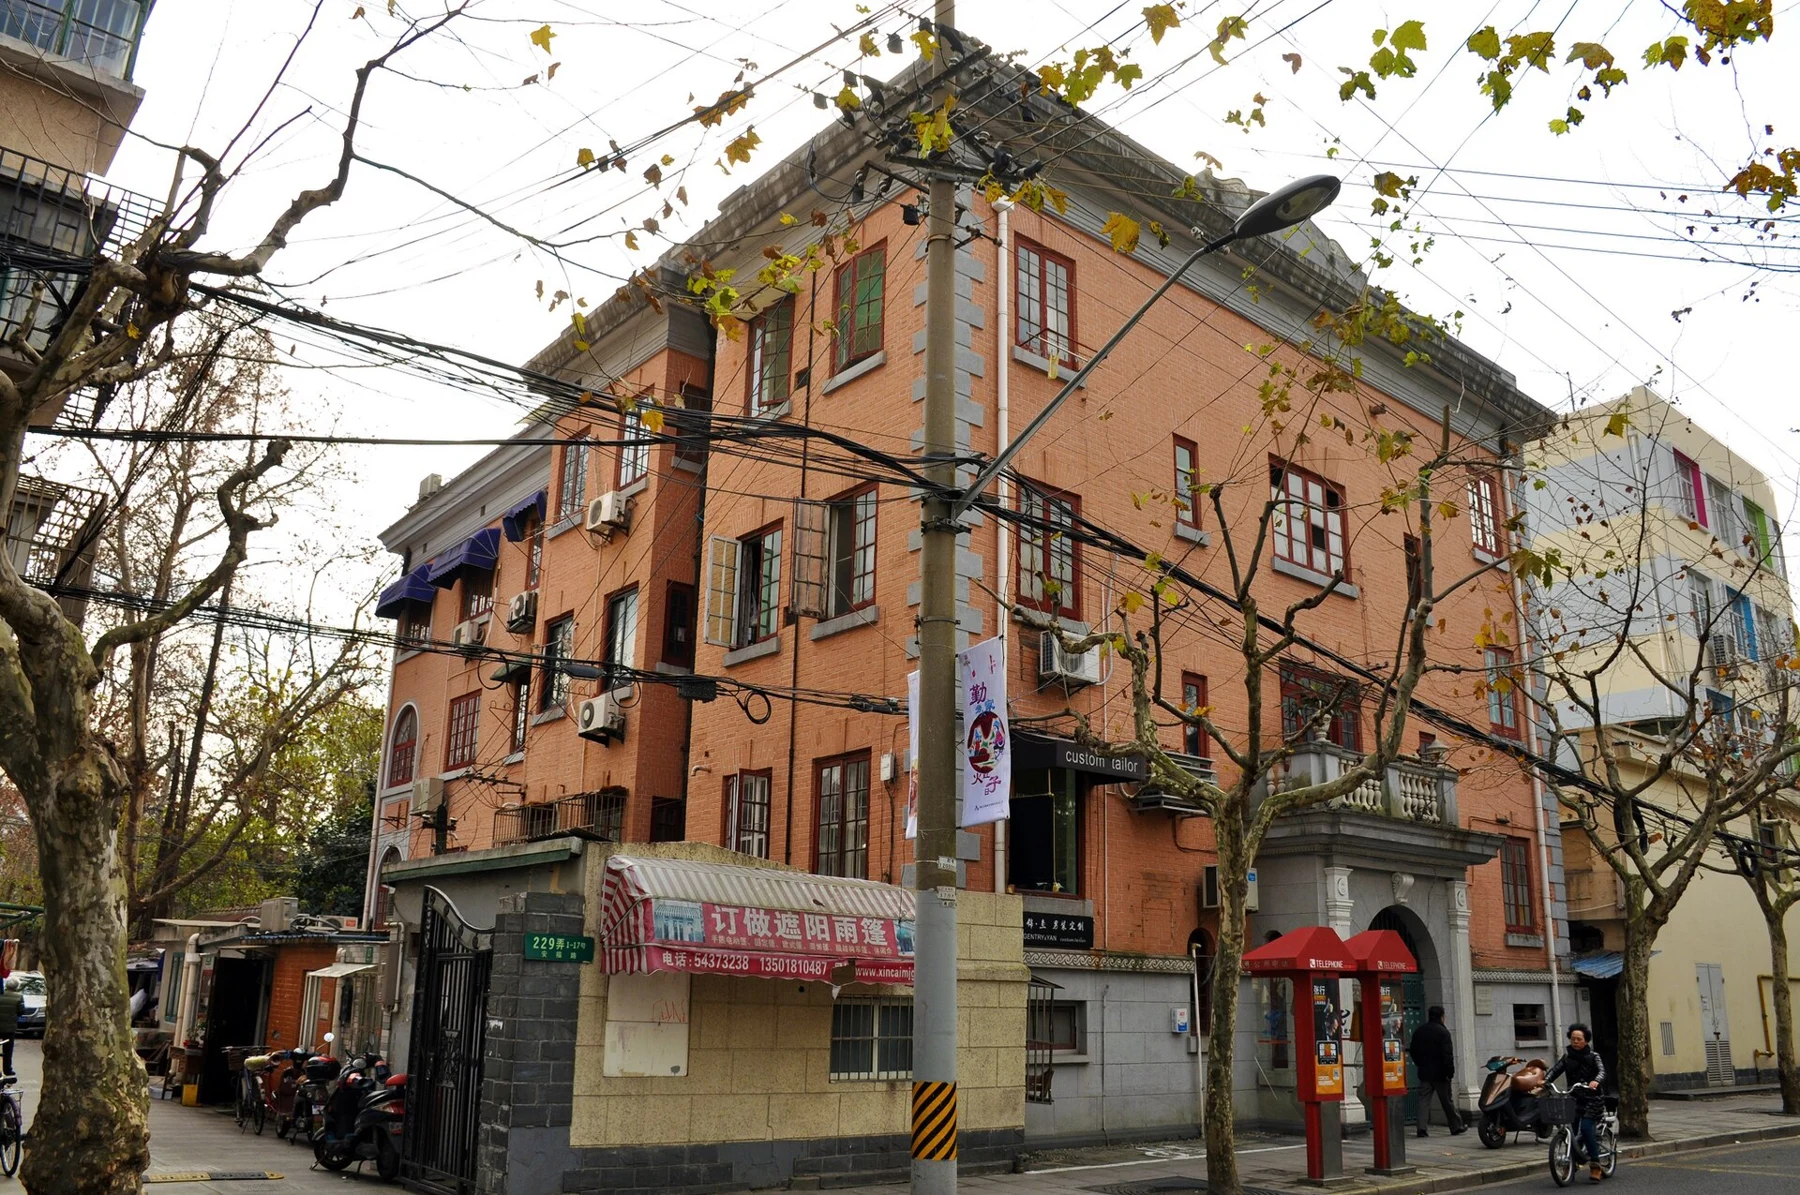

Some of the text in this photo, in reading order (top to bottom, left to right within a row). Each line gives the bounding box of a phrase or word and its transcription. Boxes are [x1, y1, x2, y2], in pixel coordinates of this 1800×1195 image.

[969, 682, 987, 706] 勤
[1065, 751, 1138, 772] custom tailor
[533, 936, 565, 950] 229弄
[541, 950, 577, 960] 安福路
[760, 957, 828, 975] 13501810487
[1316, 960, 1343, 969] TELEPHONE
[1382, 961, 1406, 970] TELEPHONE
